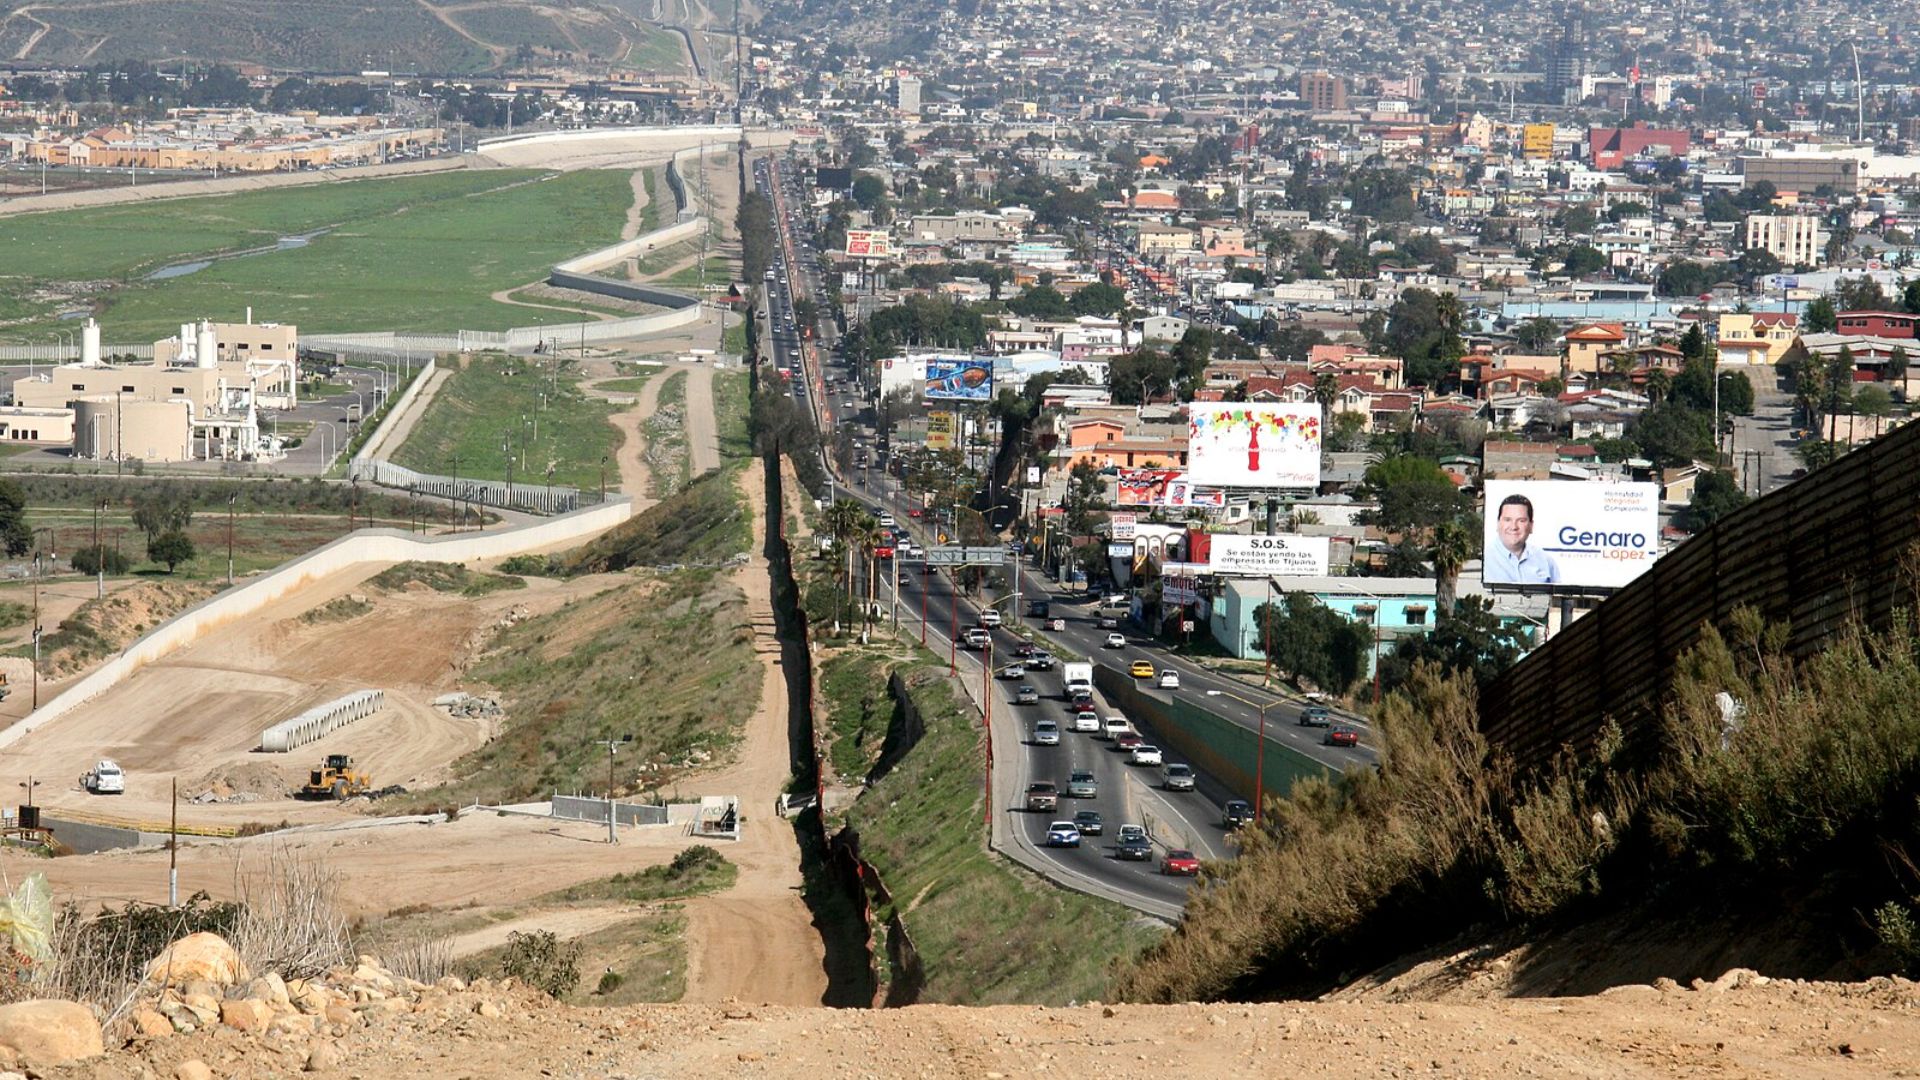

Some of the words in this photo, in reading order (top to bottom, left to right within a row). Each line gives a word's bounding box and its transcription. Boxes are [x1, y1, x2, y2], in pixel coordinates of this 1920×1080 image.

[1559, 526, 1646, 548] Genaro
[1250, 539, 1289, 549] S.O.S.
[1298, 551, 1312, 559] las
[1221, 557, 1266, 566] empresas
[1283, 558, 1317, 567] Tijuana
